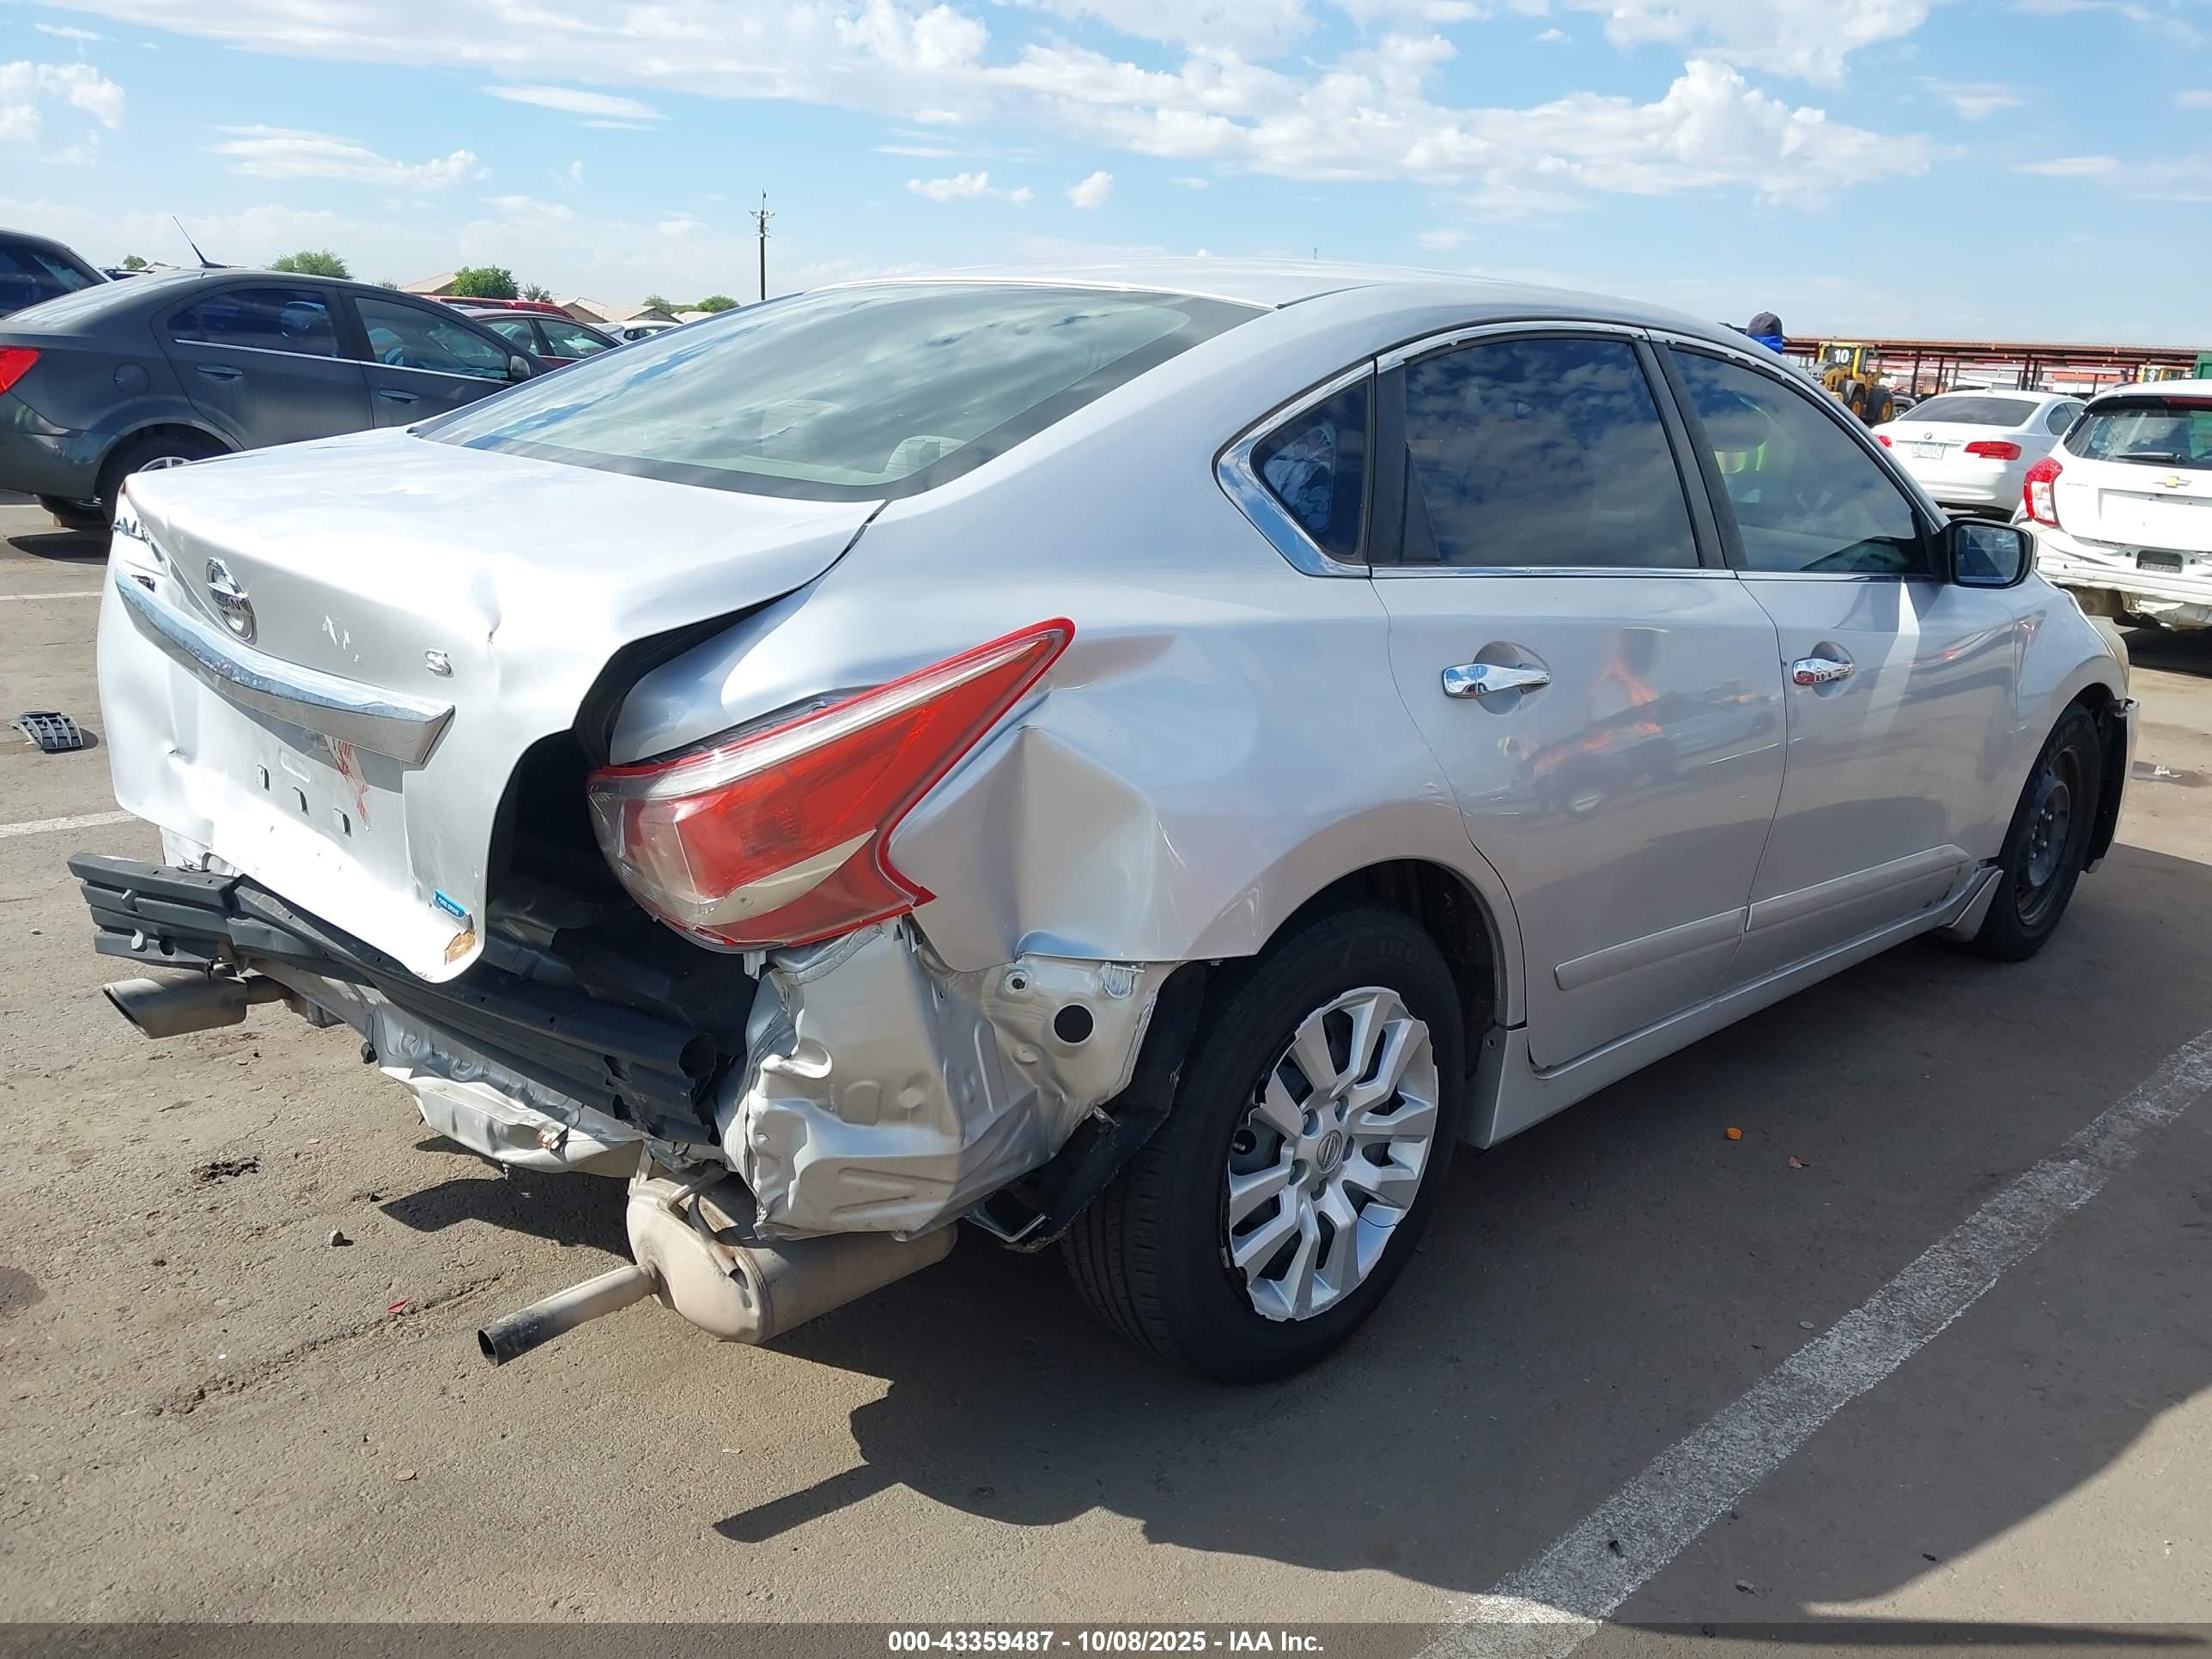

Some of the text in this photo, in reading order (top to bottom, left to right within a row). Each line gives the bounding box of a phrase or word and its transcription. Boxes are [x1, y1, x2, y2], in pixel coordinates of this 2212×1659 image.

[1834, 349, 1850, 364] 10
[2148, 369, 2156, 382] 9
[425, 647, 453, 678] S
